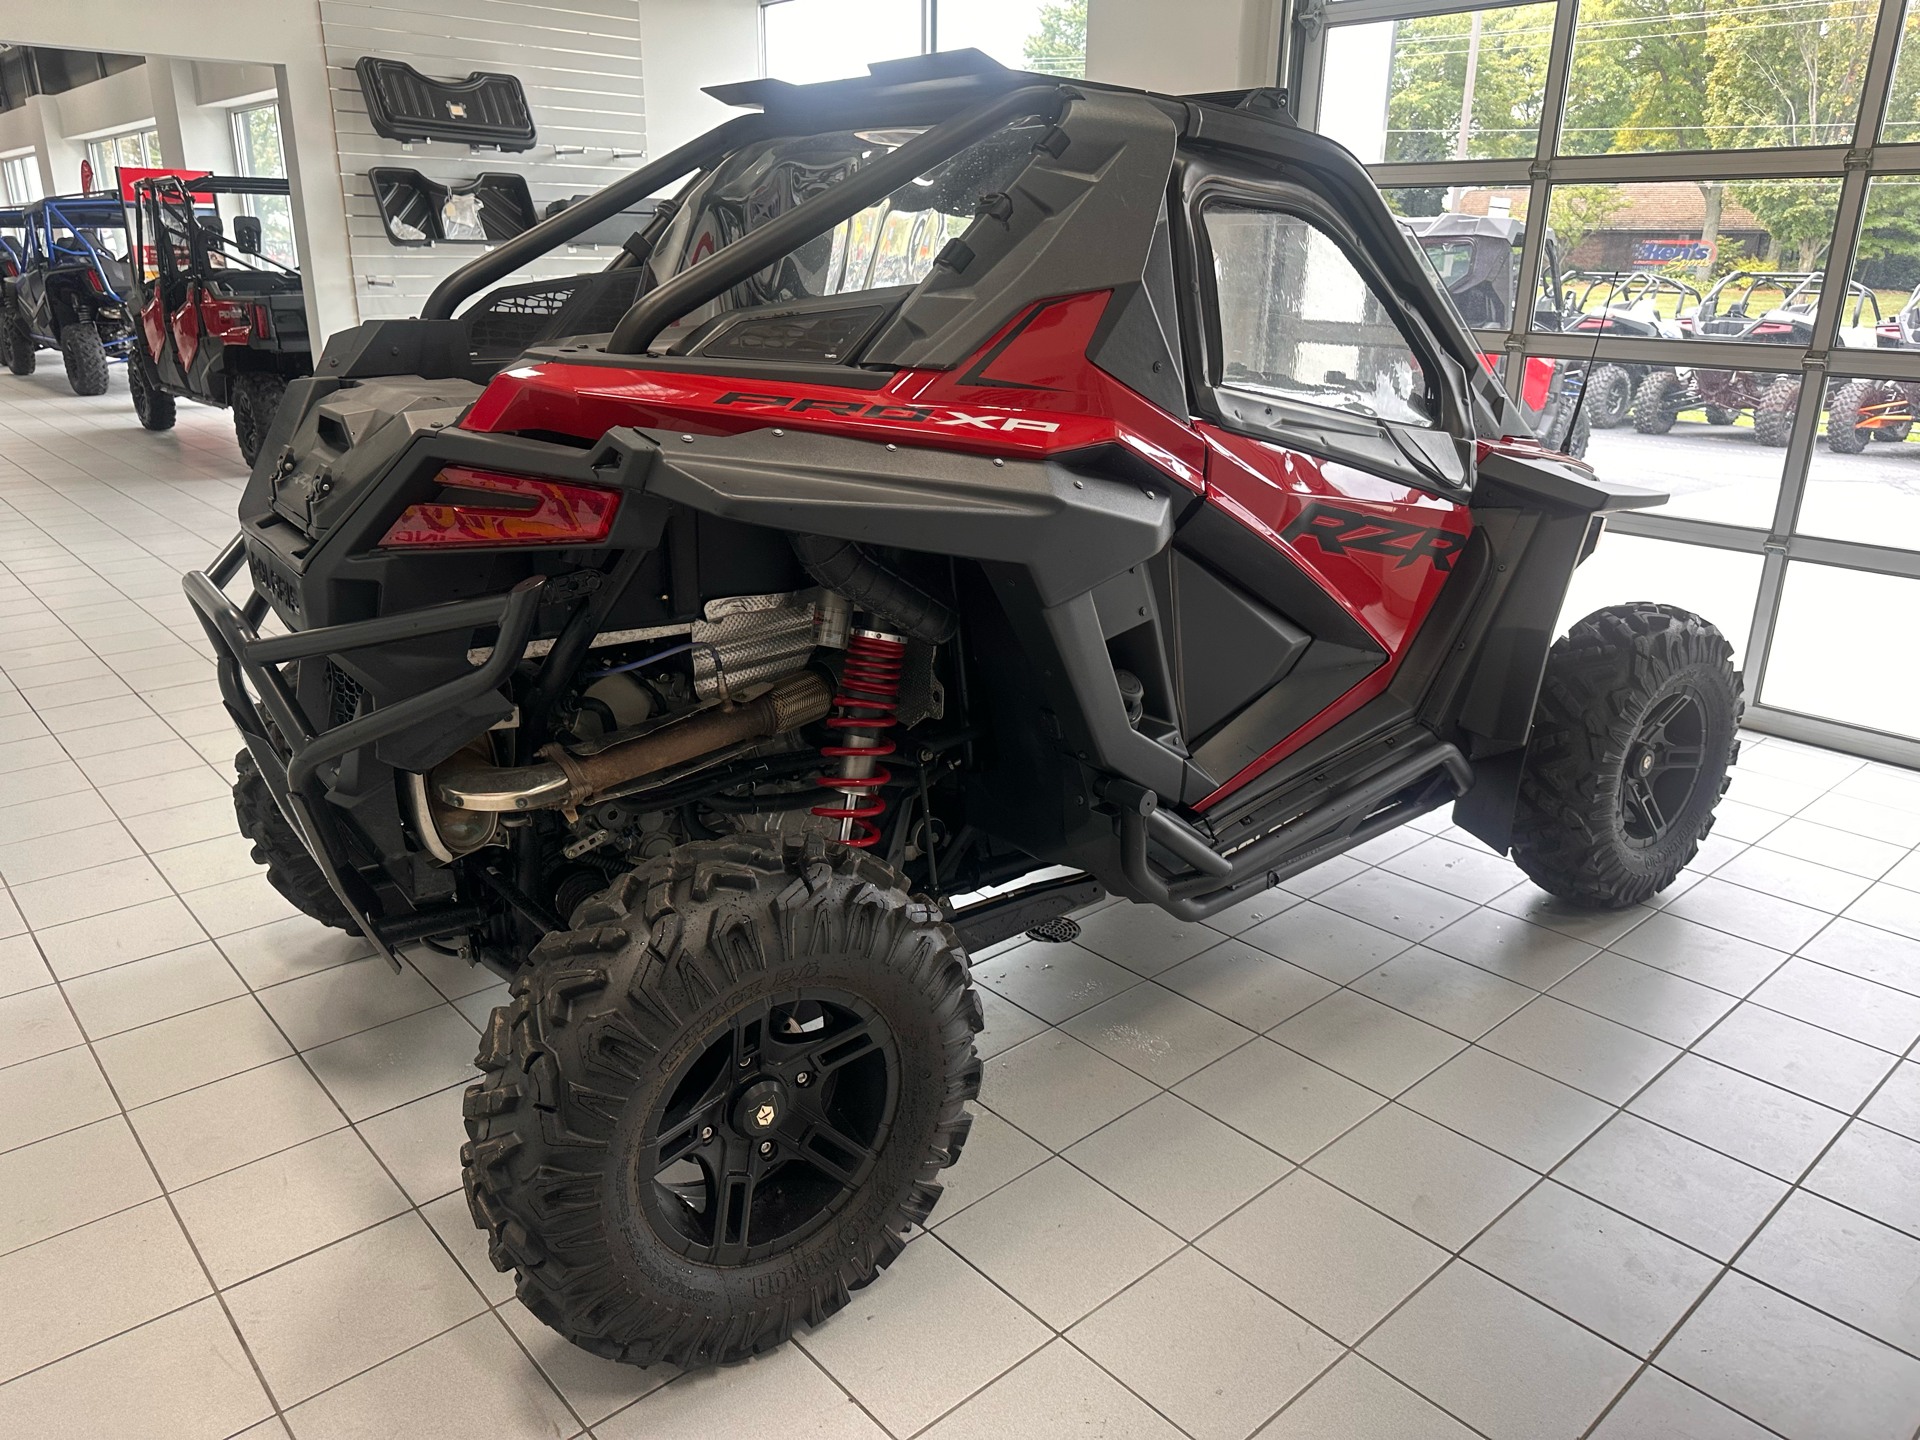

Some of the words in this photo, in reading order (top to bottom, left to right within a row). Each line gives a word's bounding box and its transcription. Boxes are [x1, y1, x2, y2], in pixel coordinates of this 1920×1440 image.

[1661, 255, 1711, 274] Sports
[713, 391, 936, 423] PRO
[936, 411, 1061, 433] XP
[1279, 502, 1468, 572] RZR
